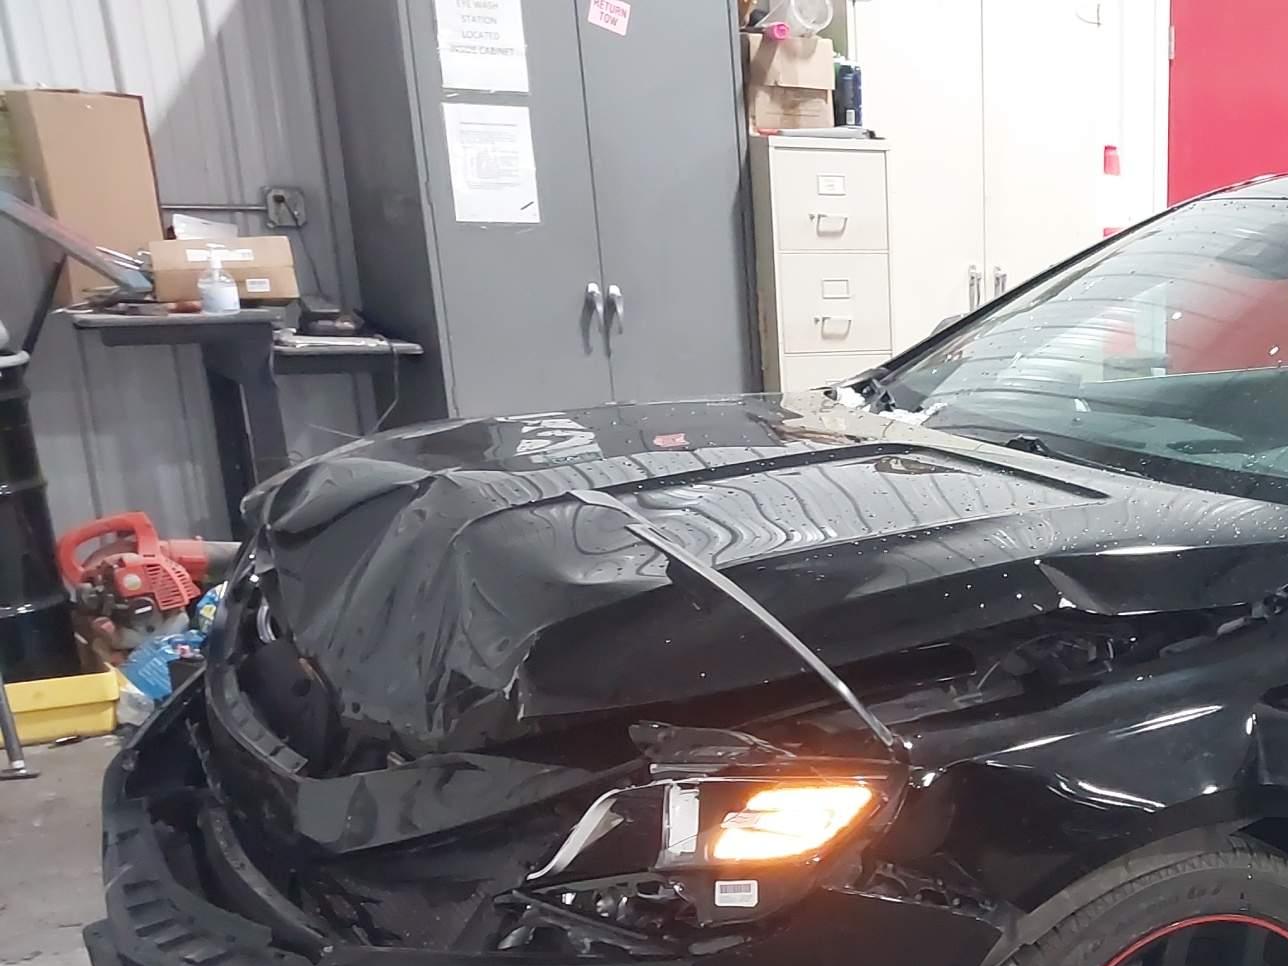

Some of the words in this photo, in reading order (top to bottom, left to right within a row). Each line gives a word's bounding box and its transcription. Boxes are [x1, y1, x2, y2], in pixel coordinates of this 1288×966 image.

[593, 0, 627, 19] RETURN
[461, 15, 497, 24] STATION
[600, 11, 618, 26] TOW
[462, 31, 500, 40] LOCATED
